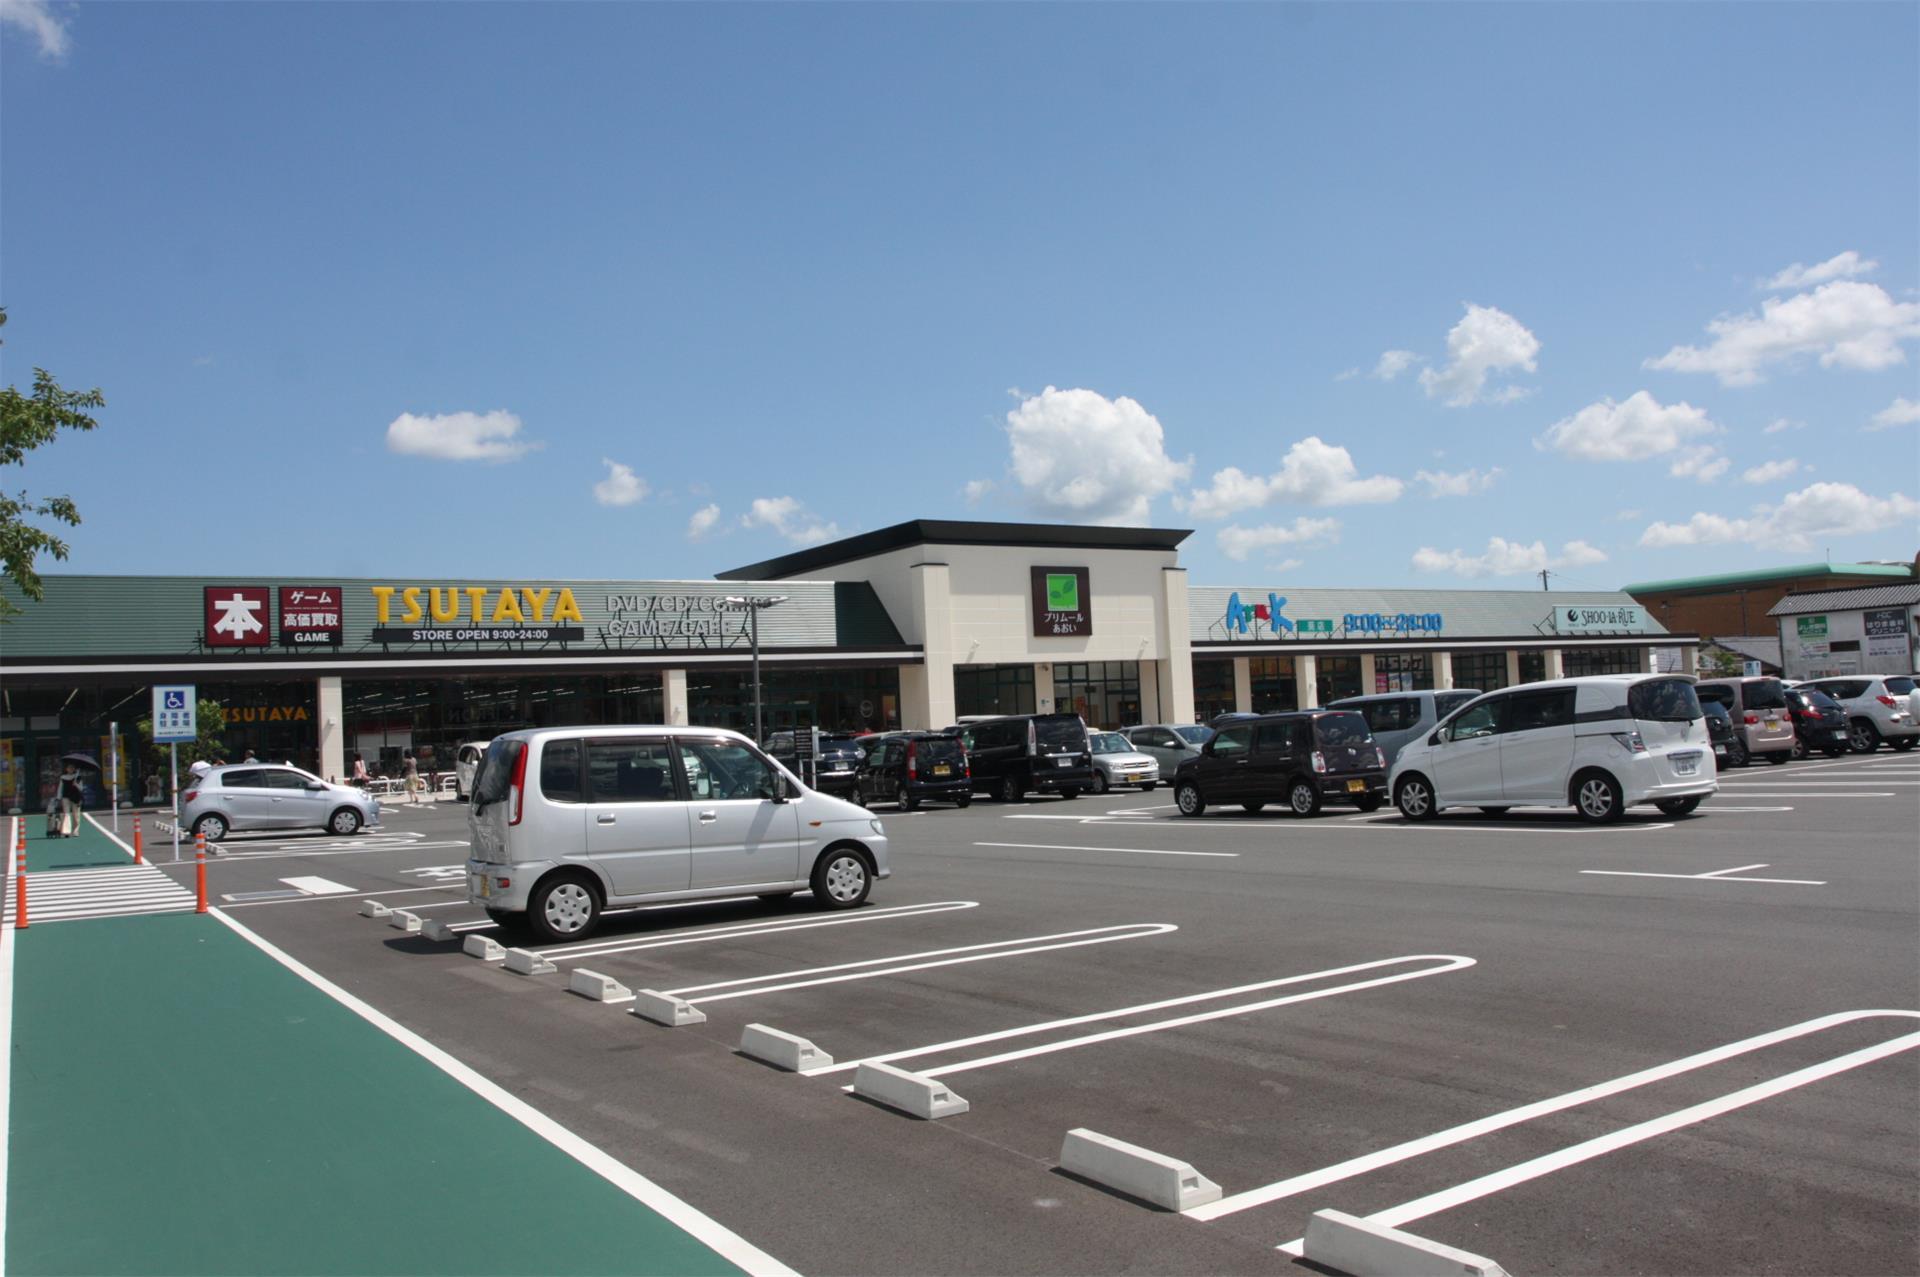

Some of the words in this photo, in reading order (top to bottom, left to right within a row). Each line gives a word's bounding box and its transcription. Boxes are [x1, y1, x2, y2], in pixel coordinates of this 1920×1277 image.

[290, 591, 332, 605] ゲーム
[372, 587, 583, 623] TSUTAYA
[213, 593, 263, 640] 本
[284, 613, 338, 627] 高価買取
[1043, 612, 1084, 623] プリムール
[412, 630, 453, 640] STORE
[456, 630, 490, 640] OPEN
[492, 629, 548, 639] 9:00-24:00
[1052, 623, 1077, 633] あおい
[294, 633, 330, 642] GAME
[221, 706, 308, 722] TSUTAYA
